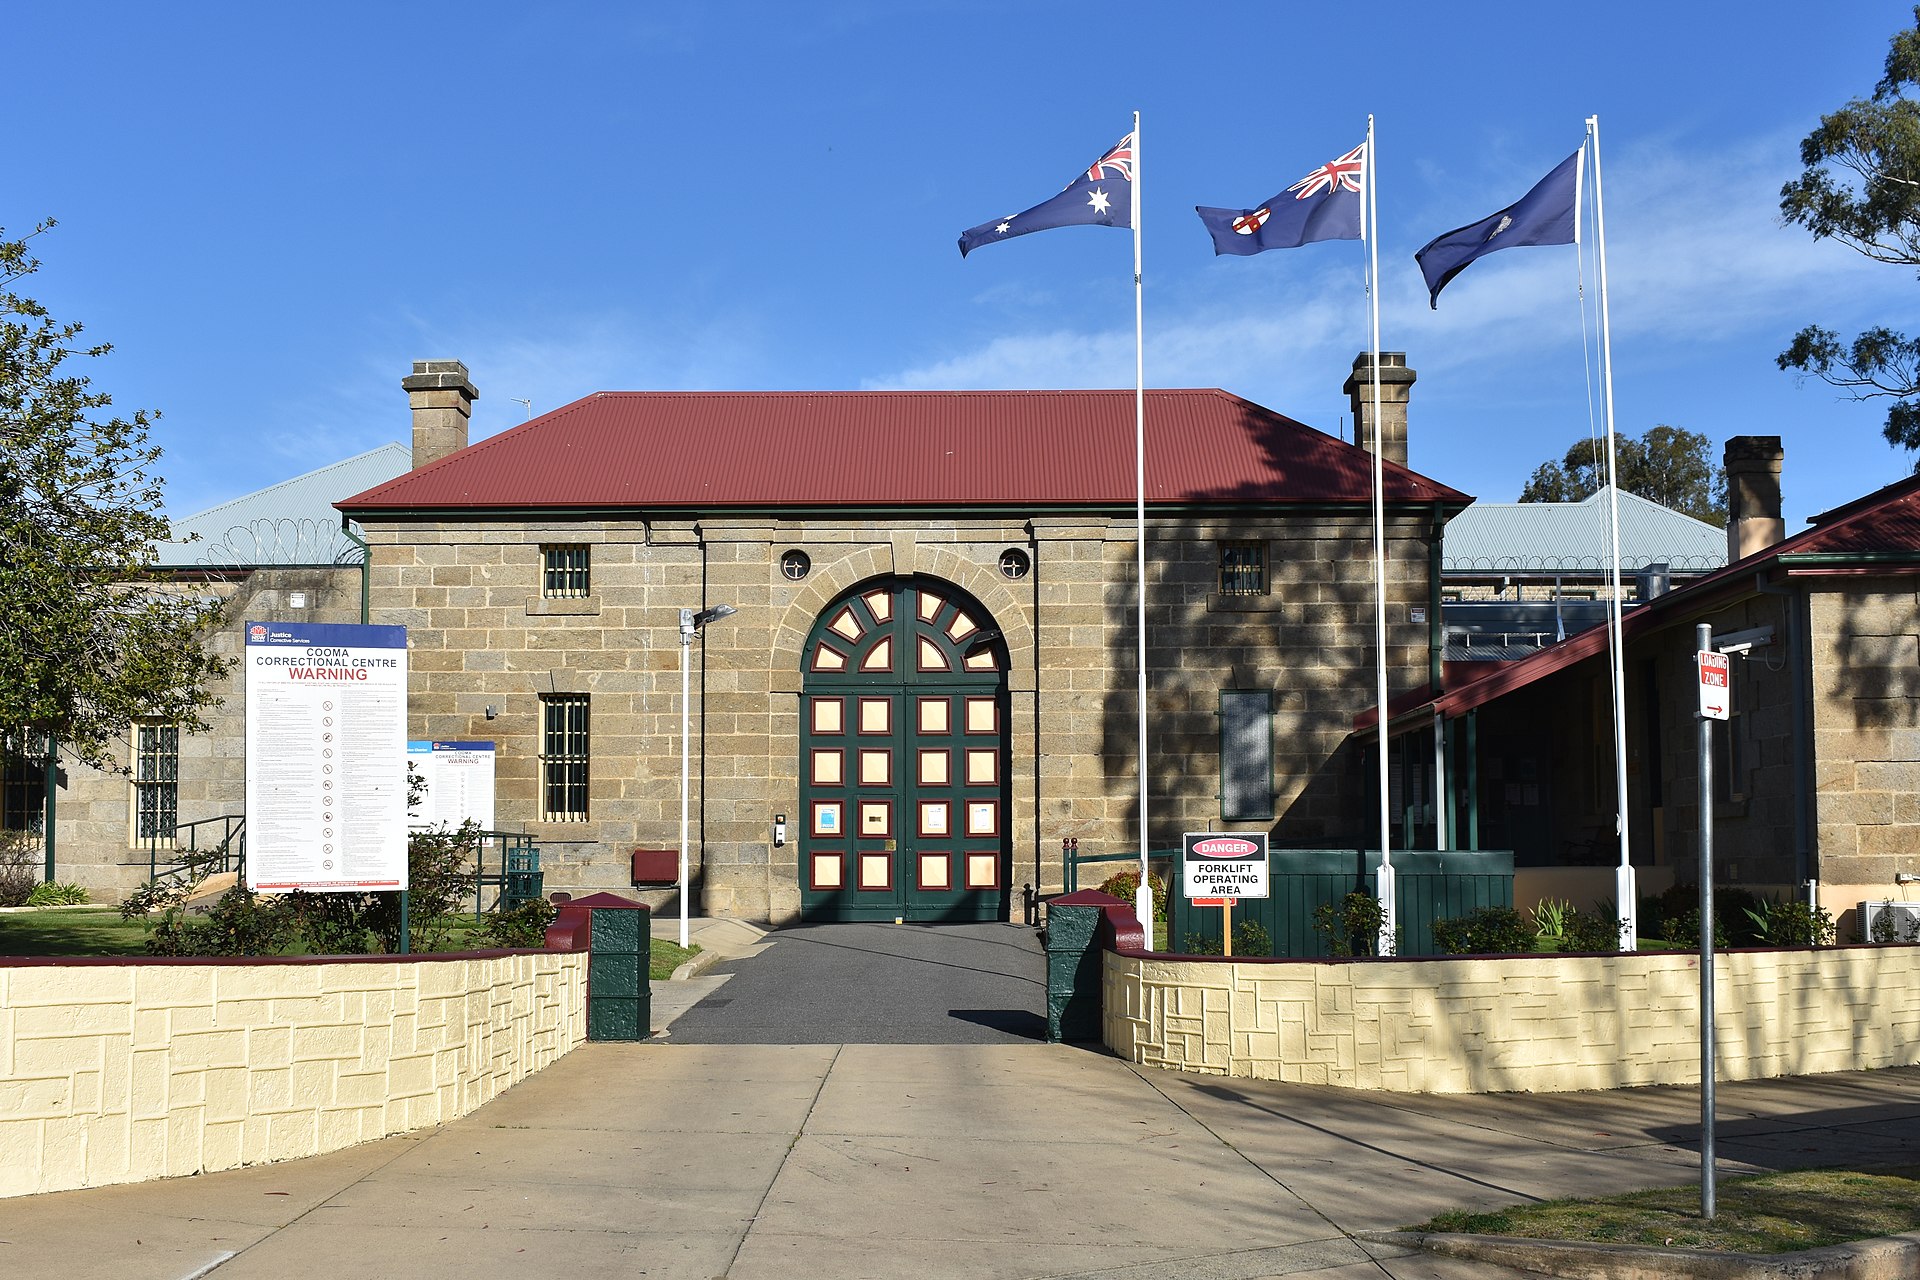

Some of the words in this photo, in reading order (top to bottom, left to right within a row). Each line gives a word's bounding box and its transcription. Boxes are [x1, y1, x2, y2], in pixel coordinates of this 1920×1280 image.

[306, 648, 350, 657] COOMA
[256, 656, 348, 667] CORRECTIONAL
[351, 658, 397, 668] CENTRE
[1700, 654, 1726, 669] LOADING
[288, 667, 368, 681] WARNING
[1704, 672, 1724, 687] ZONE
[1202, 844, 1248, 852] DANGER
[1198, 864, 1253, 873] FORKLIFT
[1193, 874, 1258, 884] OPERATING
[1210, 885, 1241, 894] AREA
